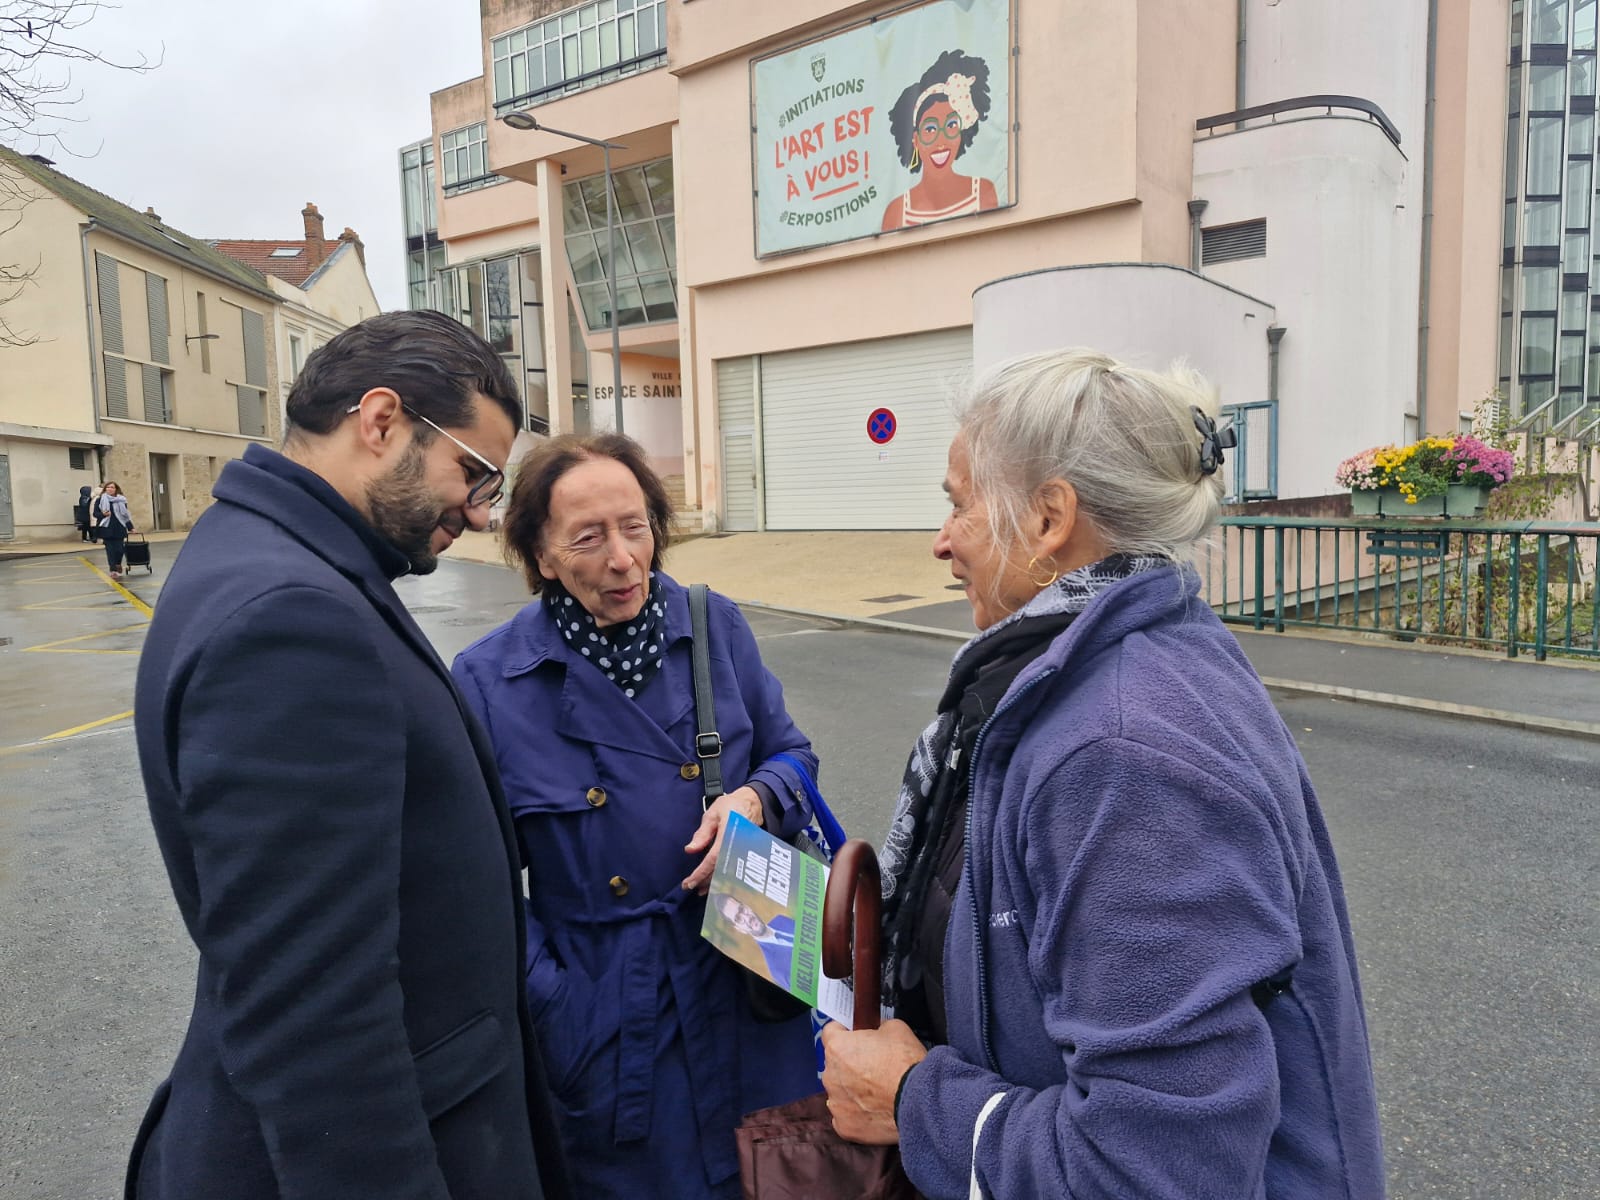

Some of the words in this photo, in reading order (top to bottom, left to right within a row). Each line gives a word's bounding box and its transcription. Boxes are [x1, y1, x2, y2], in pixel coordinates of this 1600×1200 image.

[778, 78, 865, 129] #INITIATIONS
[775, 121, 825, 169] L'ART
[834, 105, 875, 144] EST
[779, 185, 878, 227] #EXPOSITIONS
[786, 174, 801, 202] À
[594, 385, 637, 400] ESPCE
[652, 372, 672, 380] VILLE
[743, 850, 768, 894] KADIR
[765, 840, 792, 908] MEBAREK
[800, 909, 820, 949] TERRE
[796, 947, 816, 996] MELUN
